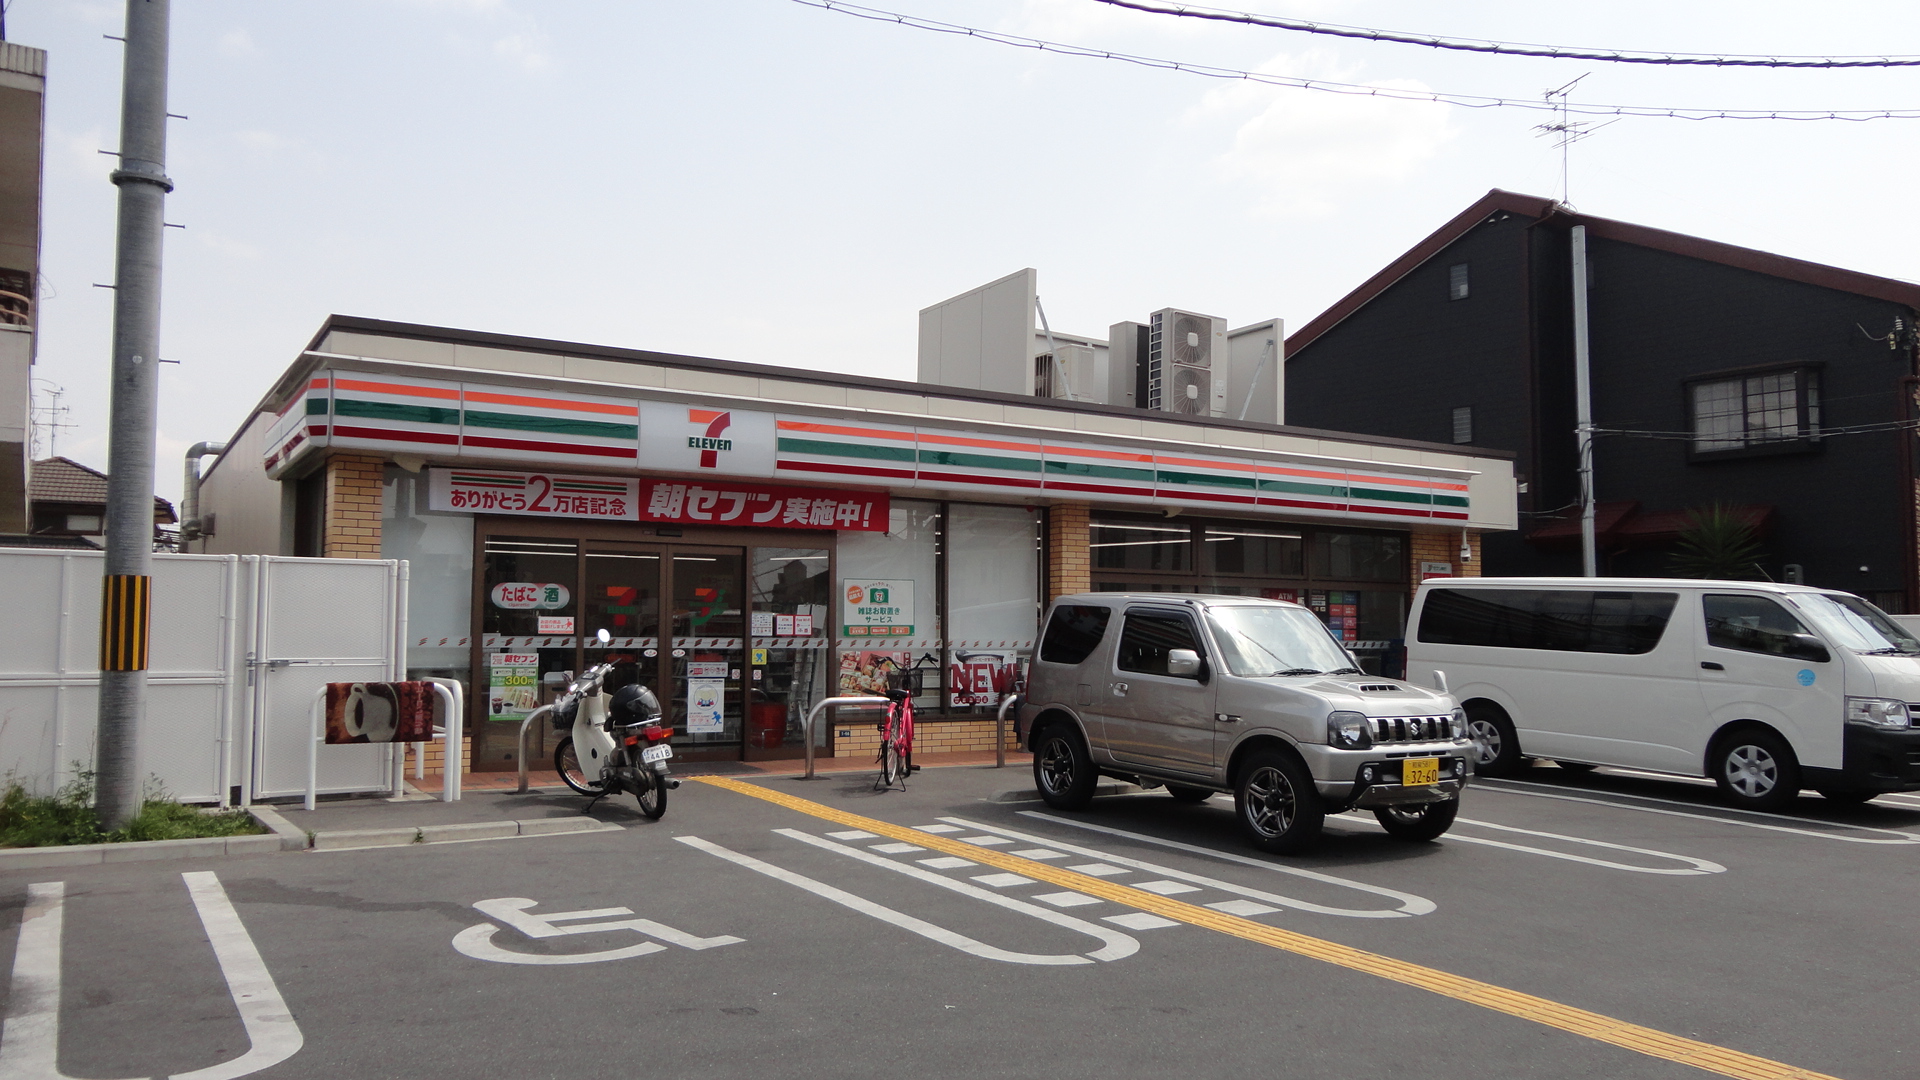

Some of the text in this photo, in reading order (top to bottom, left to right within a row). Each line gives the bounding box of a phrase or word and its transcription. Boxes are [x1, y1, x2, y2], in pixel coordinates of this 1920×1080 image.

[450, 475, 627, 516] ありがとう2万店記念
[501, 586, 559, 602] たばこ 酒
[1278, 592, 1293, 600] ATM
[858, 607, 901, 615] 雑誌お取置き
[504, 655, 537, 663] 朝セブン
[1411, 769, 1437, 784] 32-60
